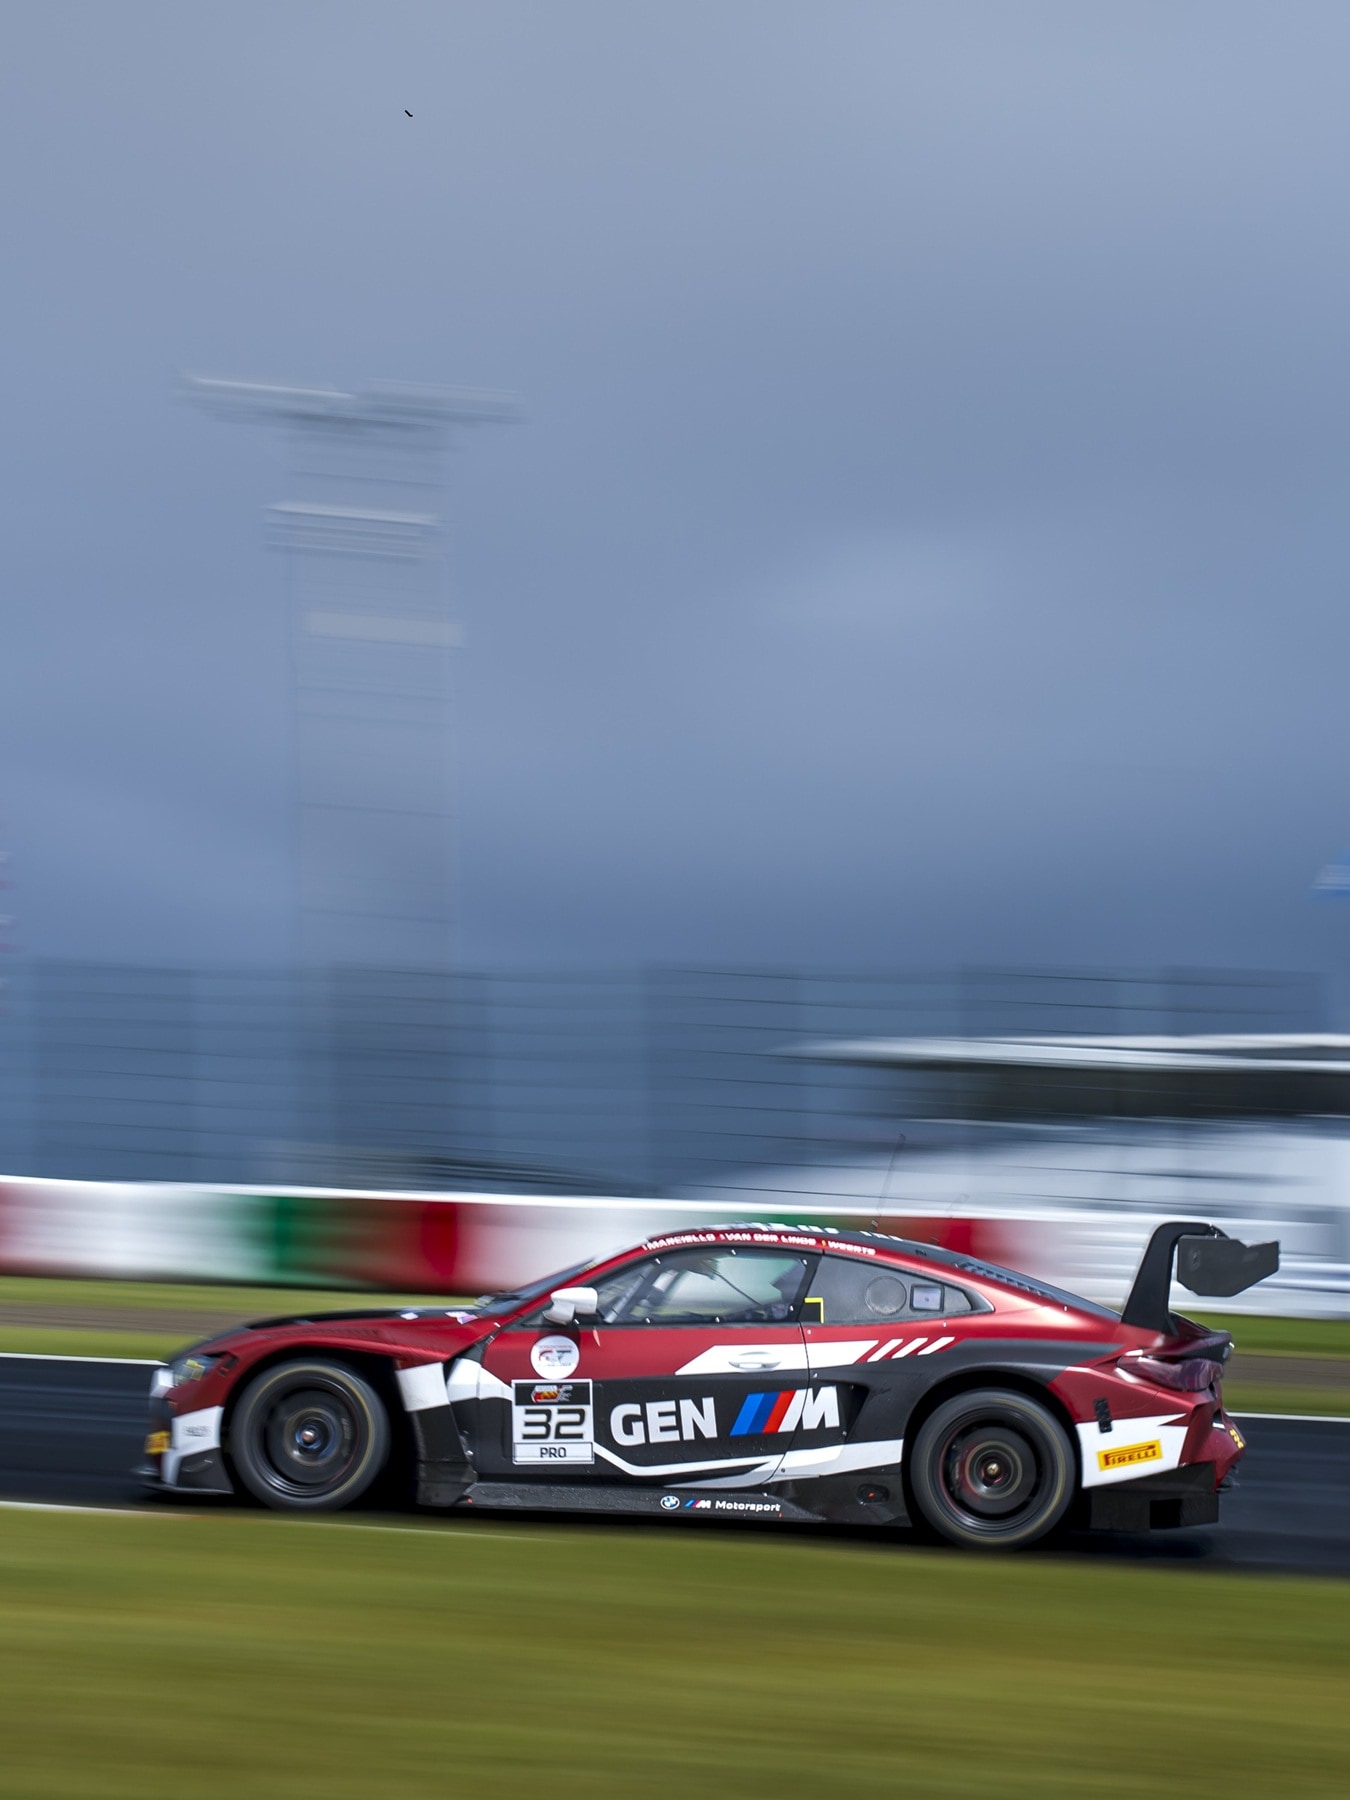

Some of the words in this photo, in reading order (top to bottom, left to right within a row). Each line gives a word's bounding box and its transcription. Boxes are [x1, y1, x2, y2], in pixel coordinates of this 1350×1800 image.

[725, 1233, 752, 1241] VAN
[522, 1408, 586, 1440] 32
[610, 1396, 718, 1447] GEN
[540, 1447, 567, 1459] PRO
[1103, 1444, 1157, 1467] PIRELLI
[715, 1500, 781, 1512] Motorsport
